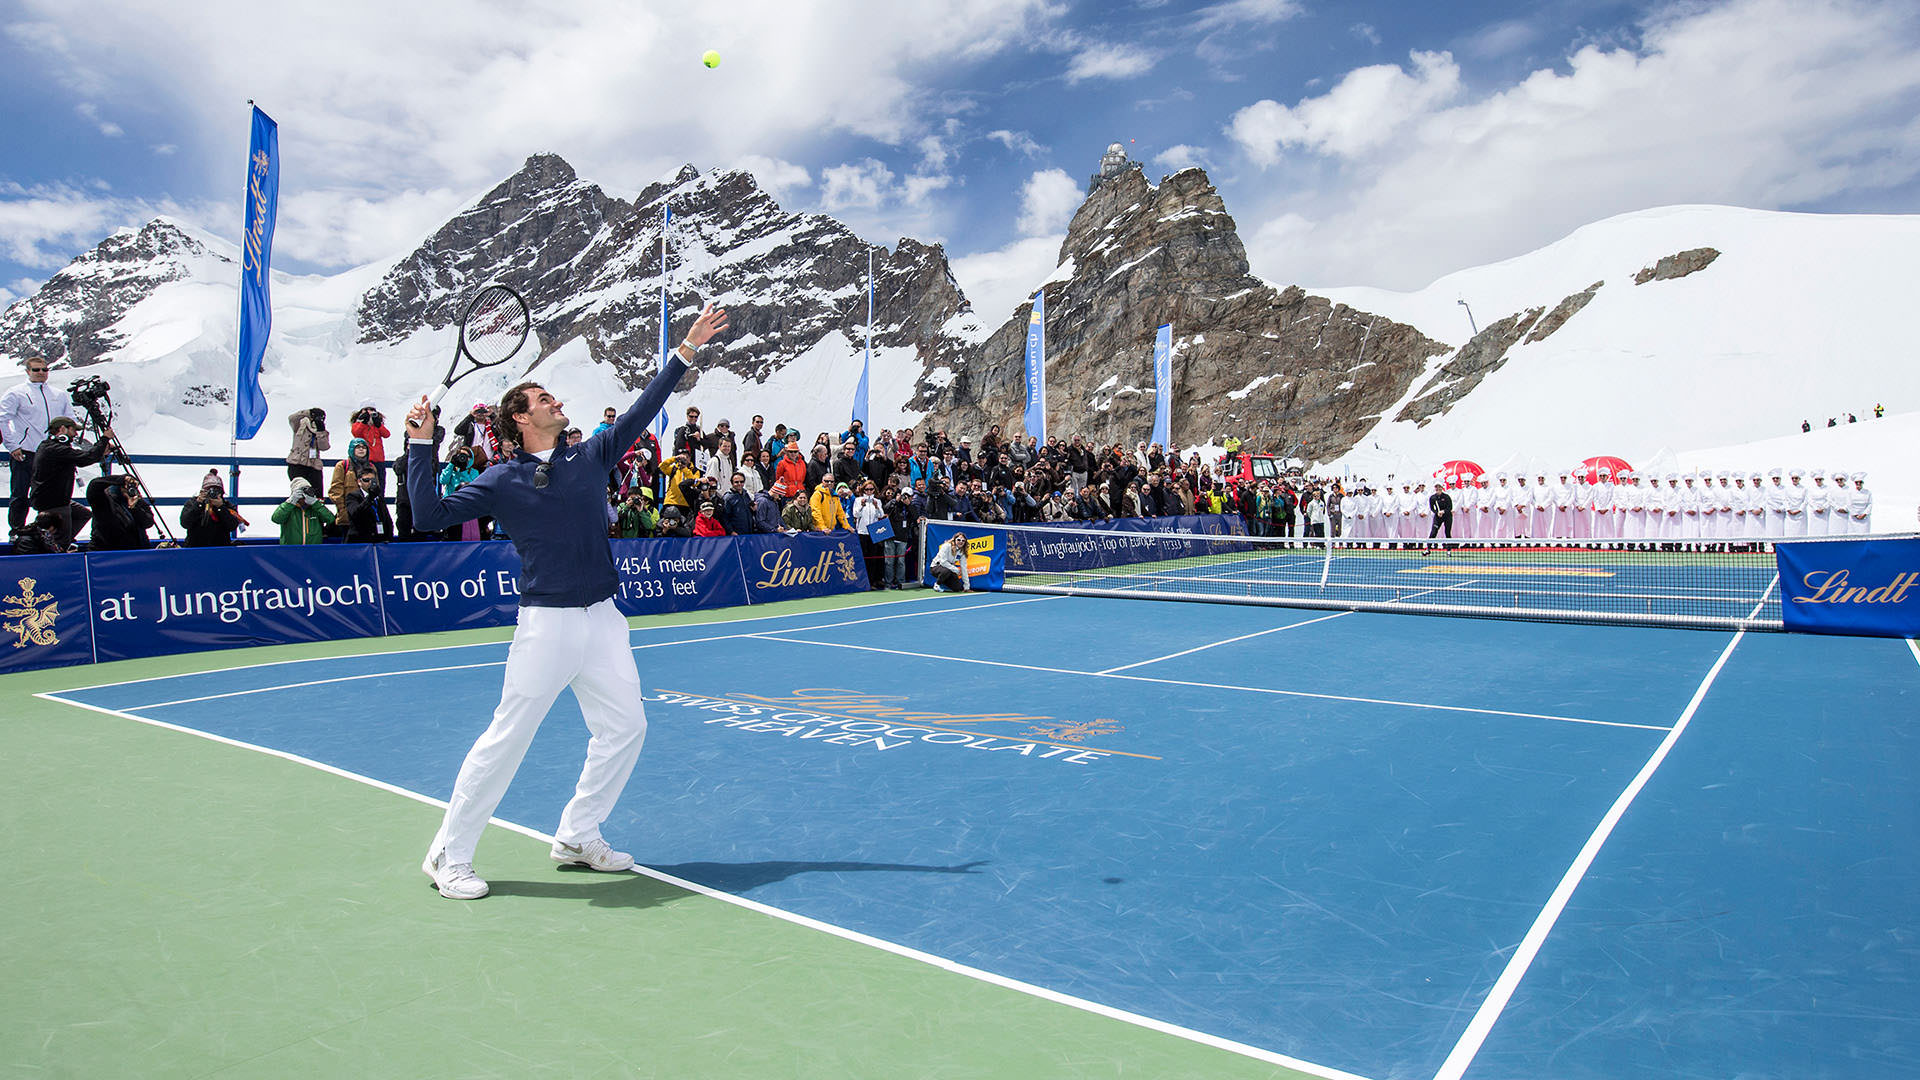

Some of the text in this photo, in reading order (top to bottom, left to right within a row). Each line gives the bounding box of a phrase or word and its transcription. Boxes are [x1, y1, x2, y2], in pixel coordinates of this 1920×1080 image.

[244, 174, 268, 287] Lindt
[970, 541, 988, 550] RAU
[1029, 542, 1039, 556] at
[1040, 535, 1098, 559] Jungfraujoch
[615, 557, 706, 575] '454 meters
[756, 548, 836, 589] Lindt
[100, 592, 137, 621] at
[156, 574, 375, 623] Jungfraujoch
[460, 569, 487, 598] of
[615, 577, 698, 600] 1'333 feet
[1792, 569, 1920, 604] Lindt
[641, 694, 1111, 764] SWISS CHOCOLATE
[703, 715, 911, 751] HEAVEN
